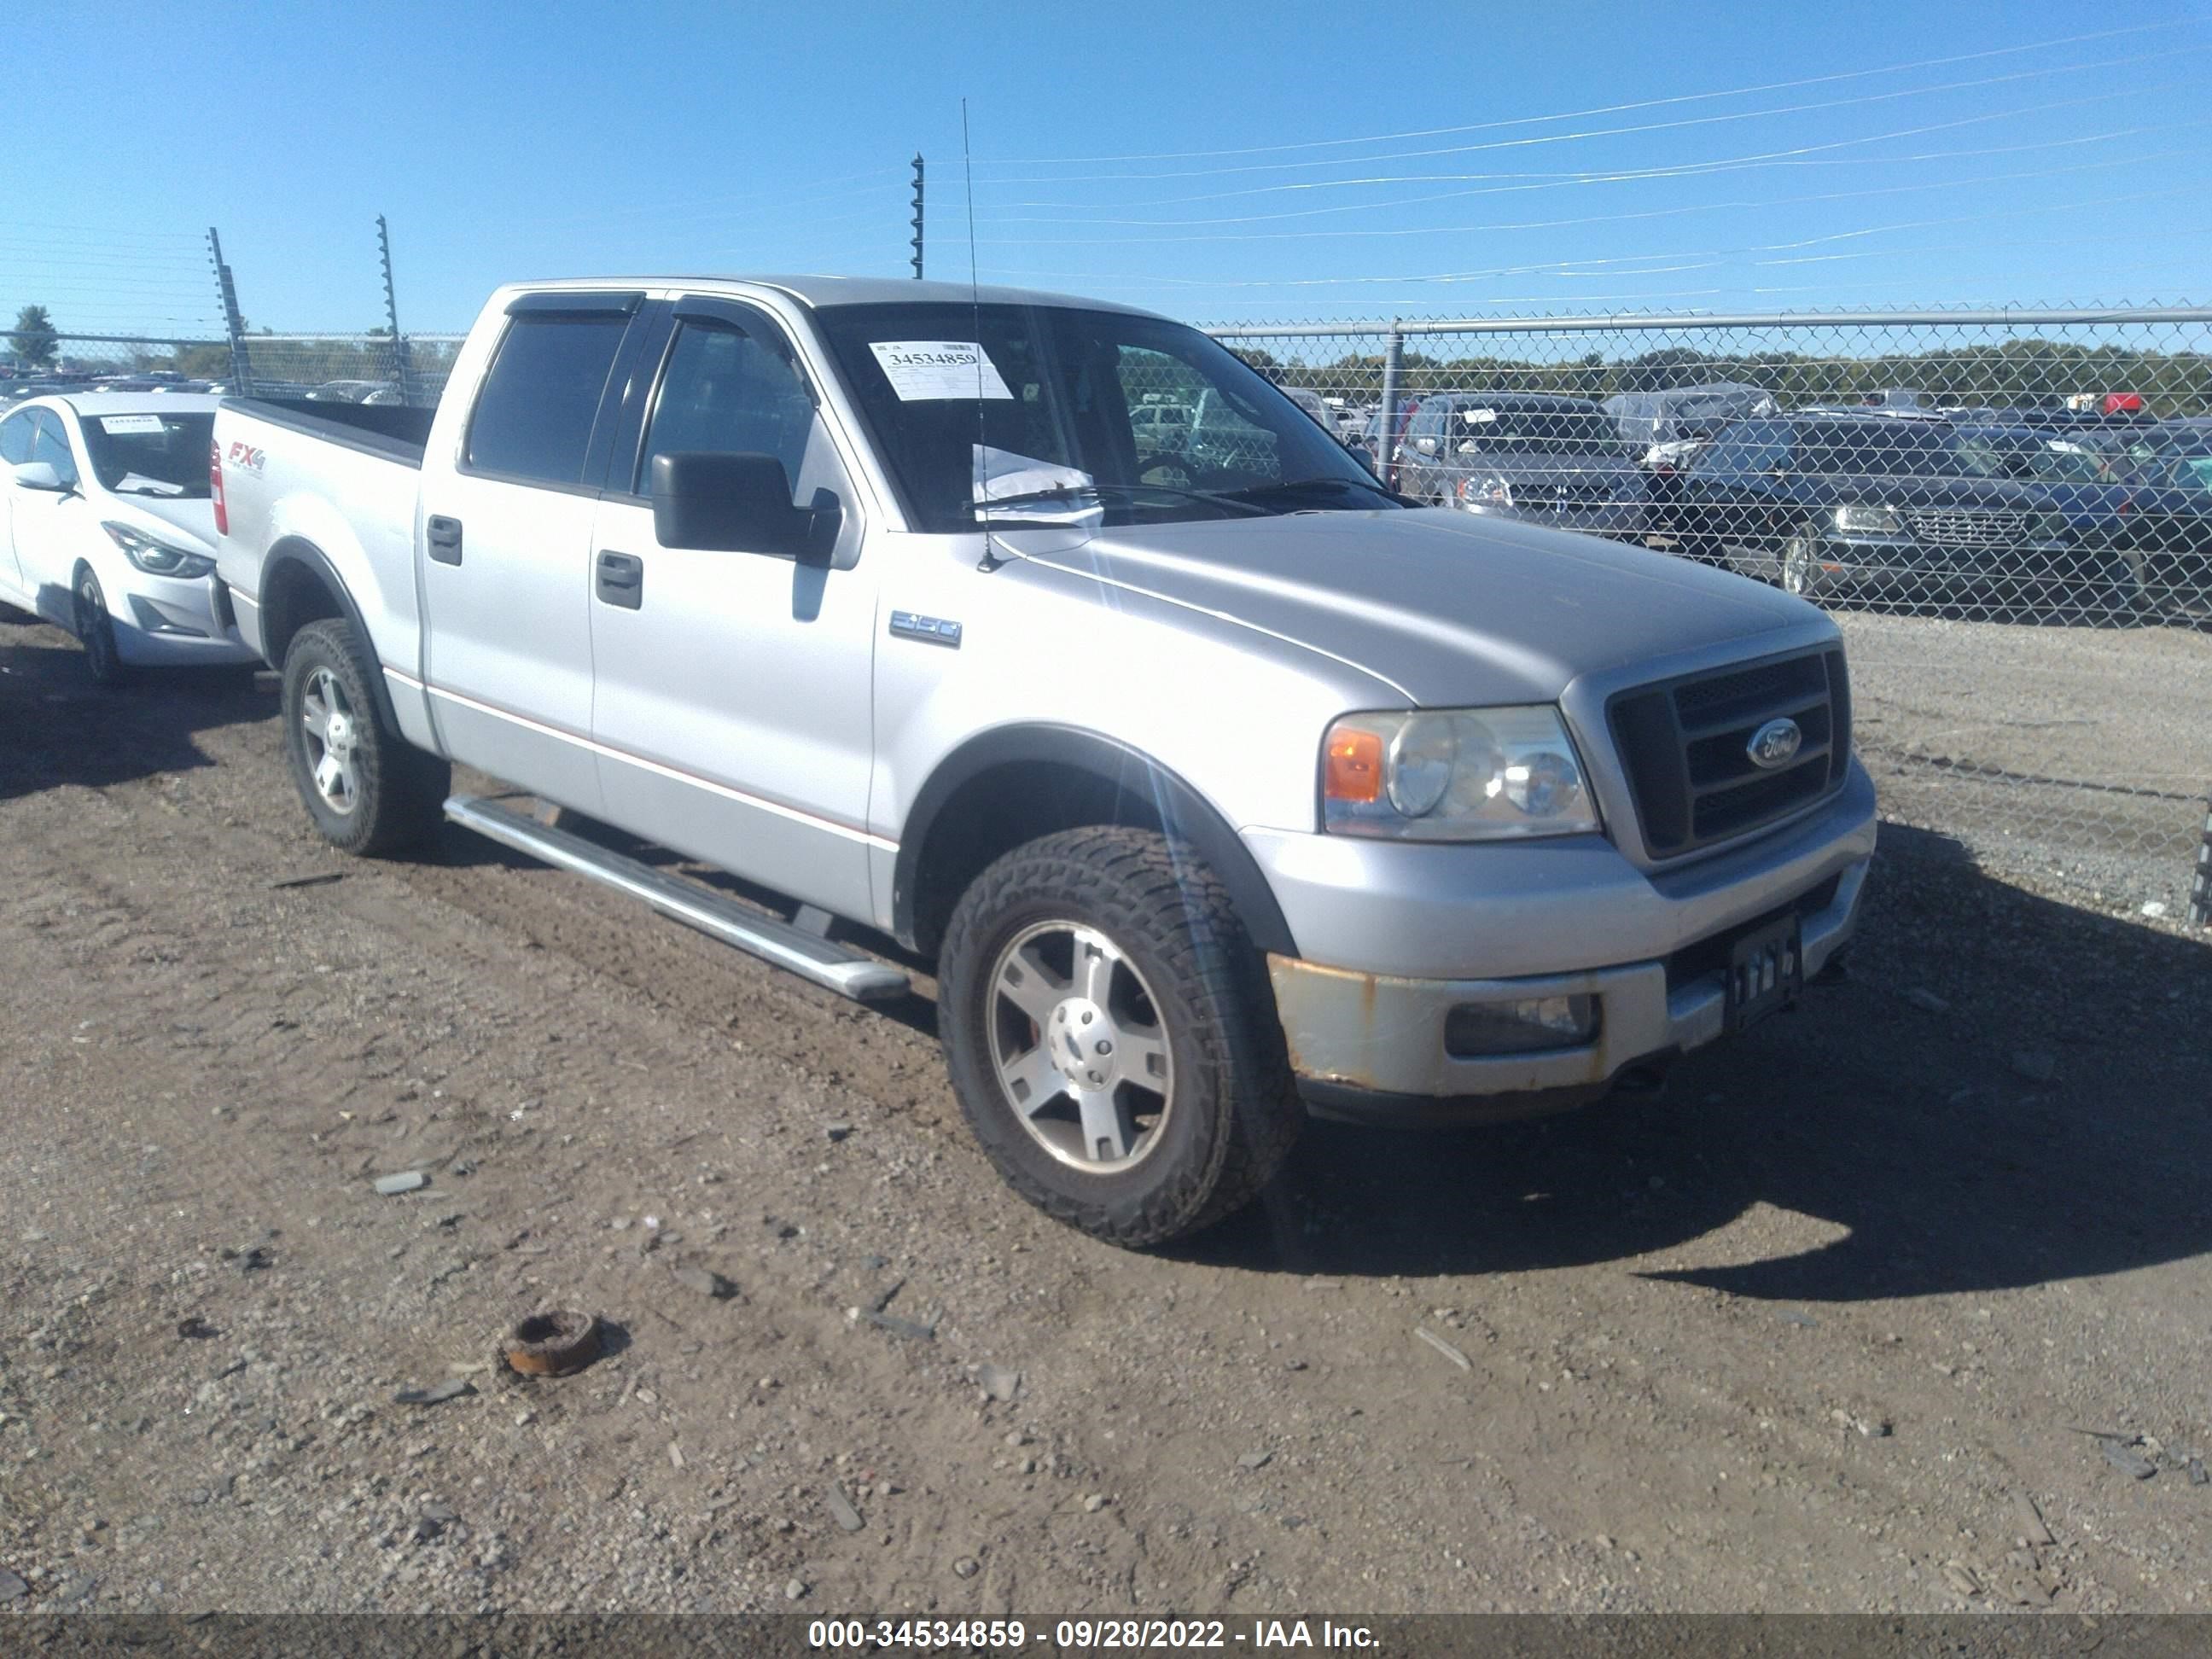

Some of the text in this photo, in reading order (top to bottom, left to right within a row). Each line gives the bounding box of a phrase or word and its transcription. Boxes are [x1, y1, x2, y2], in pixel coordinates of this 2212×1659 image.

[889, 352, 977, 365] 34534859
[228, 440, 266, 470] FX4
[1763, 728, 1792, 759] Ford
